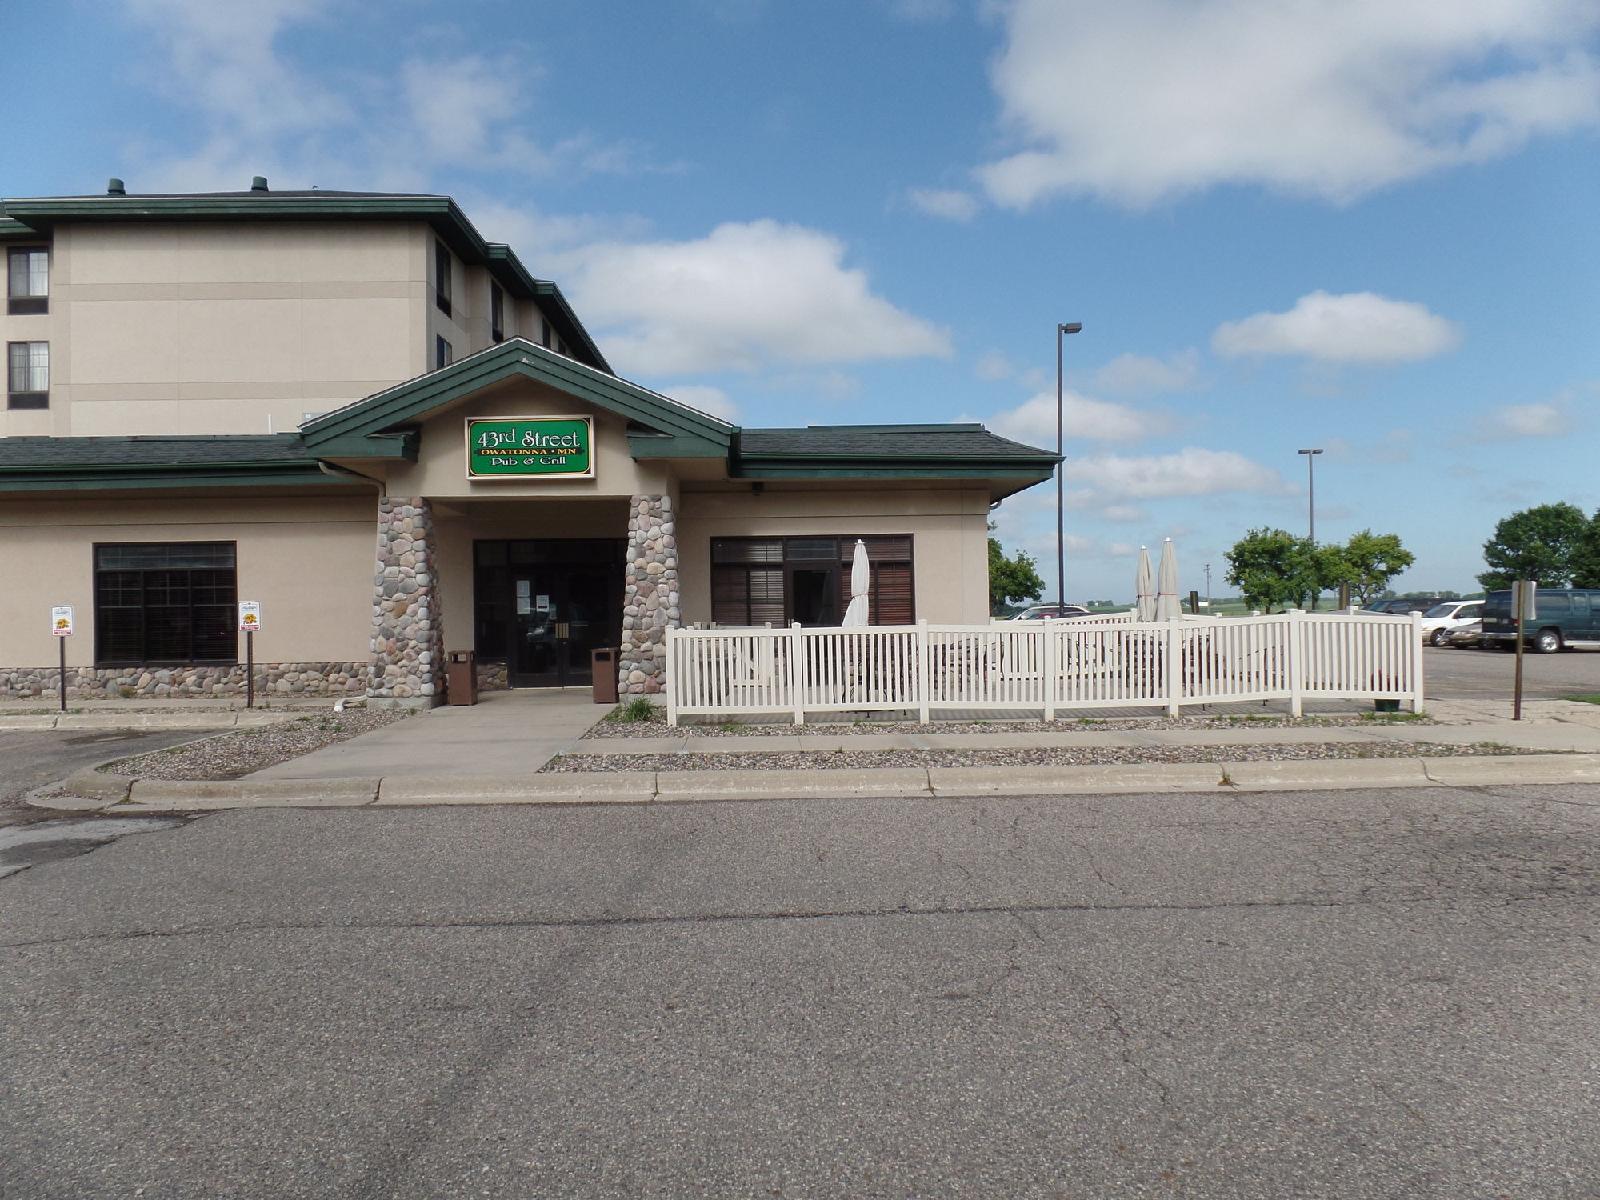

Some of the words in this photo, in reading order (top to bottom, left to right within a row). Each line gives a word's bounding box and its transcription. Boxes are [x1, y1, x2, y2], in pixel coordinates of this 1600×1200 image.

[478, 428, 516, 447] 43rd
[521, 430, 580, 447] Street
[491, 457, 518, 466] Pub
